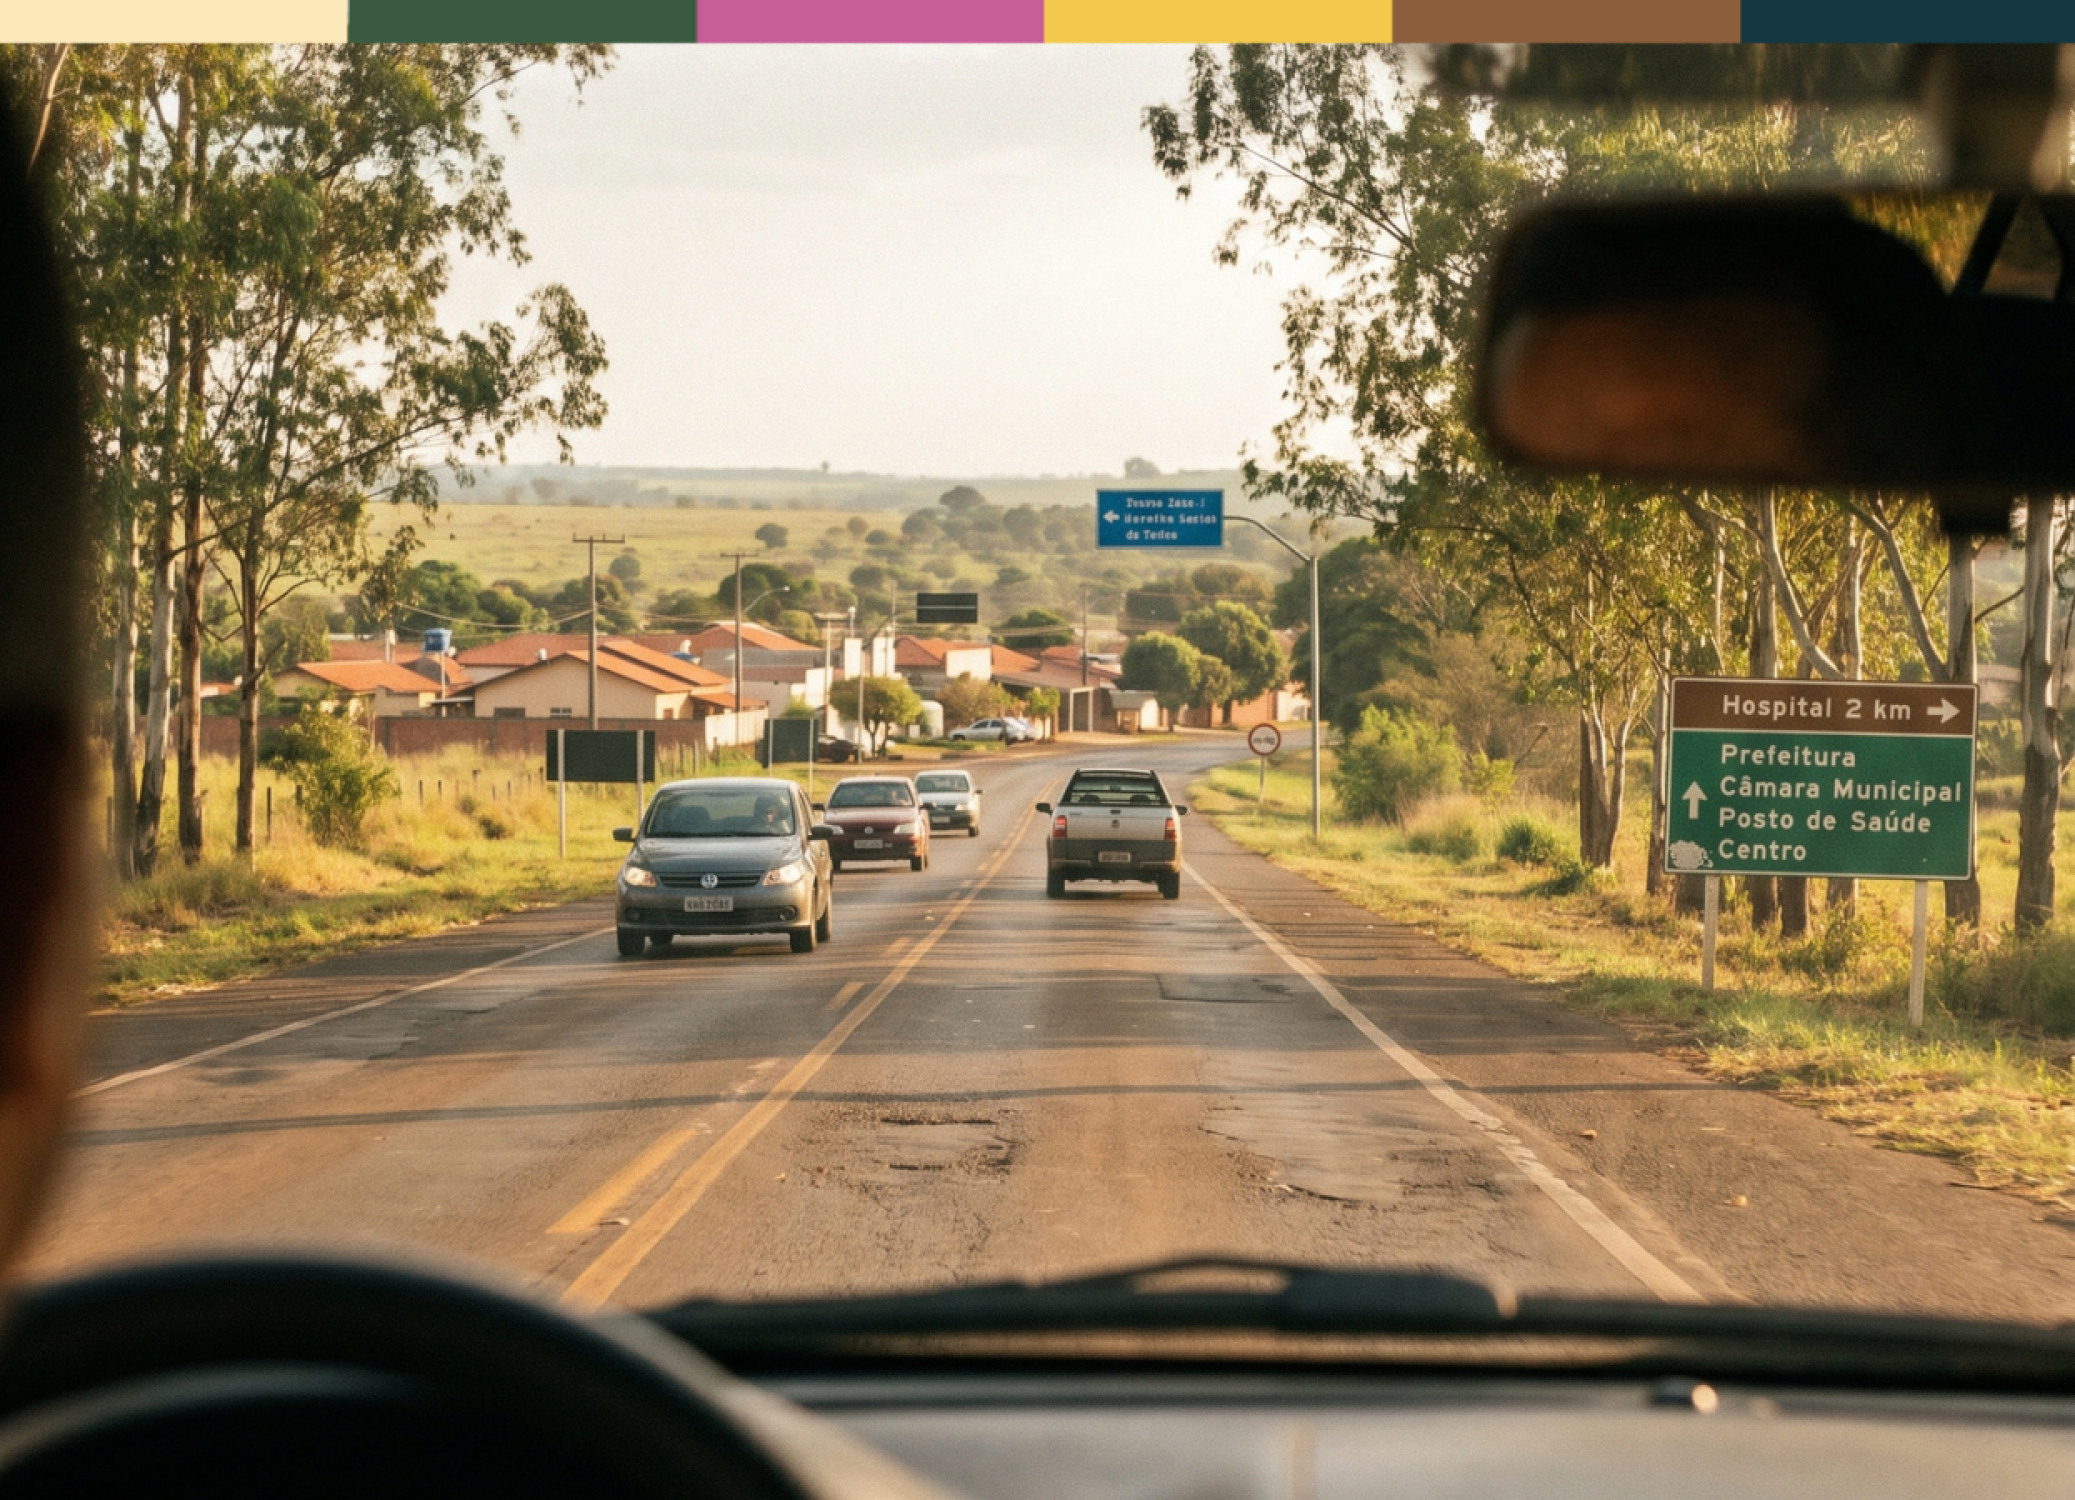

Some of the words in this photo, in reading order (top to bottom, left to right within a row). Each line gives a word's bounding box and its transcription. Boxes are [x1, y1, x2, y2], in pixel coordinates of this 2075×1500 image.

[1722, 694, 1832, 721] Hospital
[1845, 699, 1861, 719] 2
[1874, 699, 1911, 720] km
[1721, 743, 1856, 768] Prefeitura
[1719, 776, 1821, 799] Câmara
[1834, 779, 1961, 806] Municipal
[1719, 807, 1794, 830] Posto
[1807, 810, 1837, 831] de
[1850, 809, 1932, 833] Saúde
[1718, 839, 1807, 861] Centro
